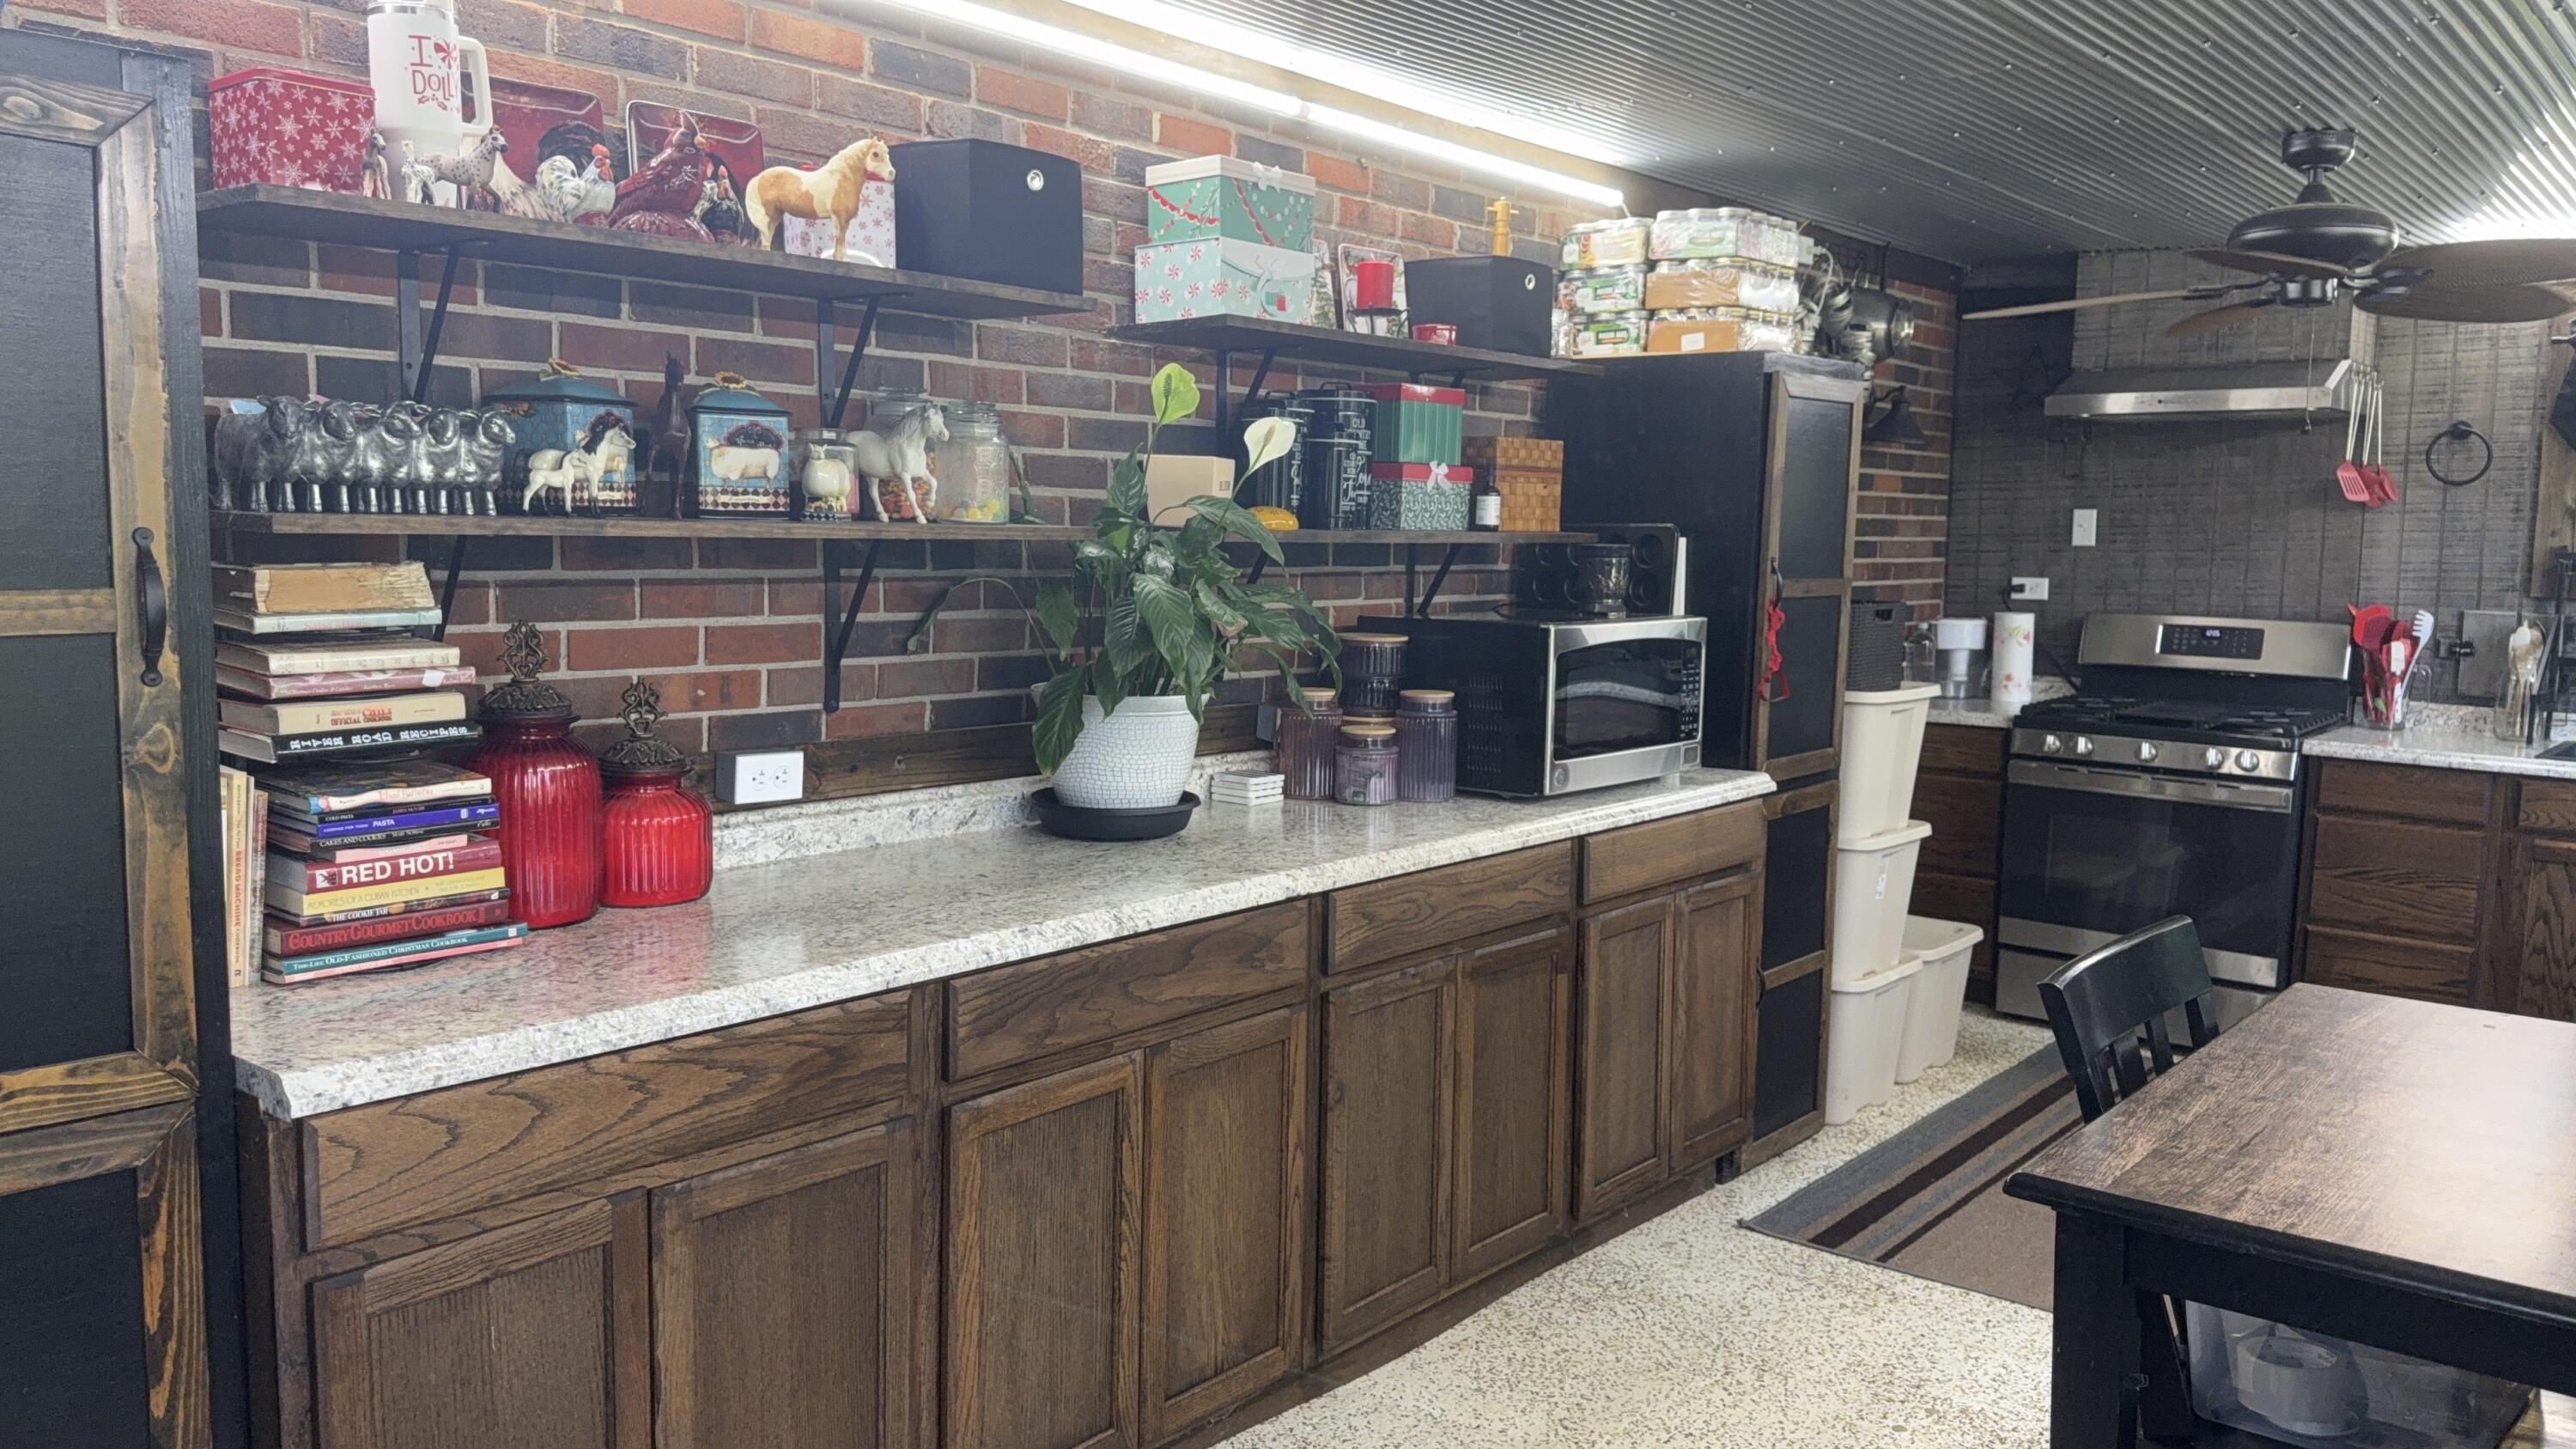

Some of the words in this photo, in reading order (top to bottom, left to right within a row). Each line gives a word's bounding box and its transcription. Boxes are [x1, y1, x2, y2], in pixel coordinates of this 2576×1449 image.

[408, 34, 433, 67] I
[290, 736, 343, 750] RIVER
[351, 732, 392, 744] ROAD
[399, 726, 467, 740] RECIPES
[373, 819, 395, 828] PASTA
[319, 837, 342, 847] CAKES
[343, 836, 359, 844] AND
[359, 833, 386, 843] COOKIES
[341, 861, 392, 885] RED
[398, 852, 454, 876] HOT!
[307, 895, 344, 910] MEMORIES
[331, 912, 348, 922] THE
[349, 909, 374, 920] COOKIE
[374, 907, 388, 916] JAR
[288, 927, 350, 950] COUNTRY
[350, 918, 411, 941] GOURMET
[411, 910, 478, 932] COOKBOOK
